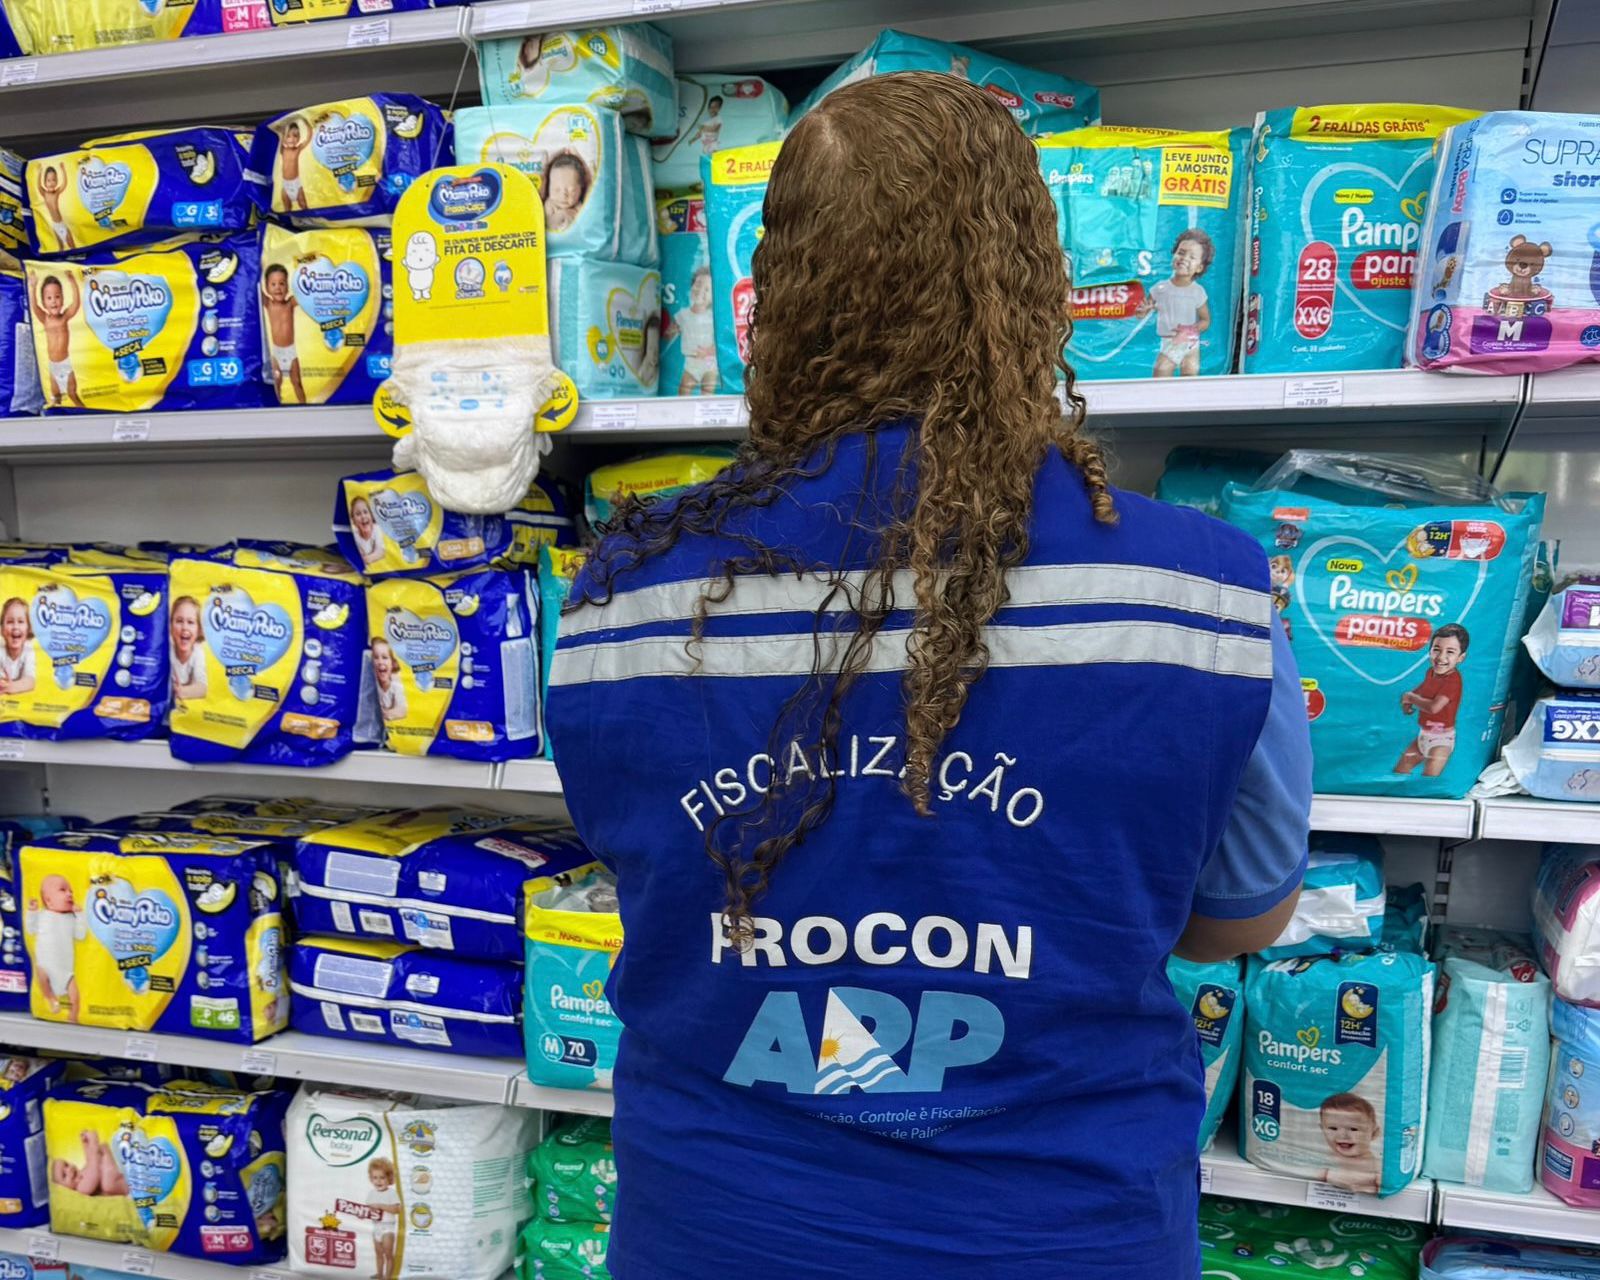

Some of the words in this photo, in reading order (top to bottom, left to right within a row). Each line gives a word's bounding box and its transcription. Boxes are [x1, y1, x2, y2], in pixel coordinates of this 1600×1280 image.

[1308, 115, 1321, 132] 2
[1322, 119, 1380, 134] FRALDAS
[727, 158, 736, 174] 2
[739, 160, 774, 174] FRALD
[1165, 151, 1191, 163] LEVE
[1195, 154, 1230, 164] JUNTO
[1049, 169, 1095, 186] Pampers
[1165, 165, 1170, 173] 1
[1175, 163, 1228, 176] AMOSTRA
[440, 183, 490, 203] MamyPoko
[1165, 175, 1227, 195] GRÁTIS
[1450, 169, 1469, 213] Baby
[1342, 207, 1420, 251] Pamp
[445, 244, 467, 256] FITA
[468, 243, 482, 254] DE
[484, 237, 538, 252] DESCARTE
[1303, 258, 1332, 281] 28
[1365, 255, 1415, 280] pan
[299, 271, 364, 294] MamyPoko
[90, 280, 166, 316] MamyPoko
[1297, 307, 1331, 325] XXG
[1497, 320, 1524, 341] M
[202, 364, 212, 376] G
[220, 363, 239, 376] 30
[1330, 560, 1359, 571] Nova
[1329, 575, 1443, 617] Pampers
[37, 603, 105, 631] MamyPoko
[210, 608, 287, 640] MamyPoko
[390, 622, 450, 643] MamyPoko
[1347, 616, 1418, 639] pants
[680, 734, 1044, 832] FISCALIZÇÃO
[93, 897, 174, 928] MamyPoko
[710, 912, 1033, 980] PROCON
[551, 984, 616, 1016] Pamper
[217, 1010, 236, 1023] 46
[559, 1013, 593, 1025] confort
[595, 1018, 612, 1027] sec
[545, 1038, 559, 1053] M
[569, 1041, 586, 1057] 70
[722, 986, 1006, 1095] ARP
[1259, 1030, 1342, 1065] Pampers
[1267, 1057, 1307, 1073] confort
[1309, 1064, 1328, 1075] sec
[1257, 1090, 1274, 1106] 18
[859, 1109, 917, 1124] Controle
[312, 1121, 373, 1142] Personal
[891, 1128, 908, 1140] de
[1253, 1117, 1277, 1137] XG
[330, 1140, 354, 1152] baby
[337, 1199, 382, 1220] PANTS
[231, 1233, 249, 1246] 40
[335, 1240, 354, 1254] 50
